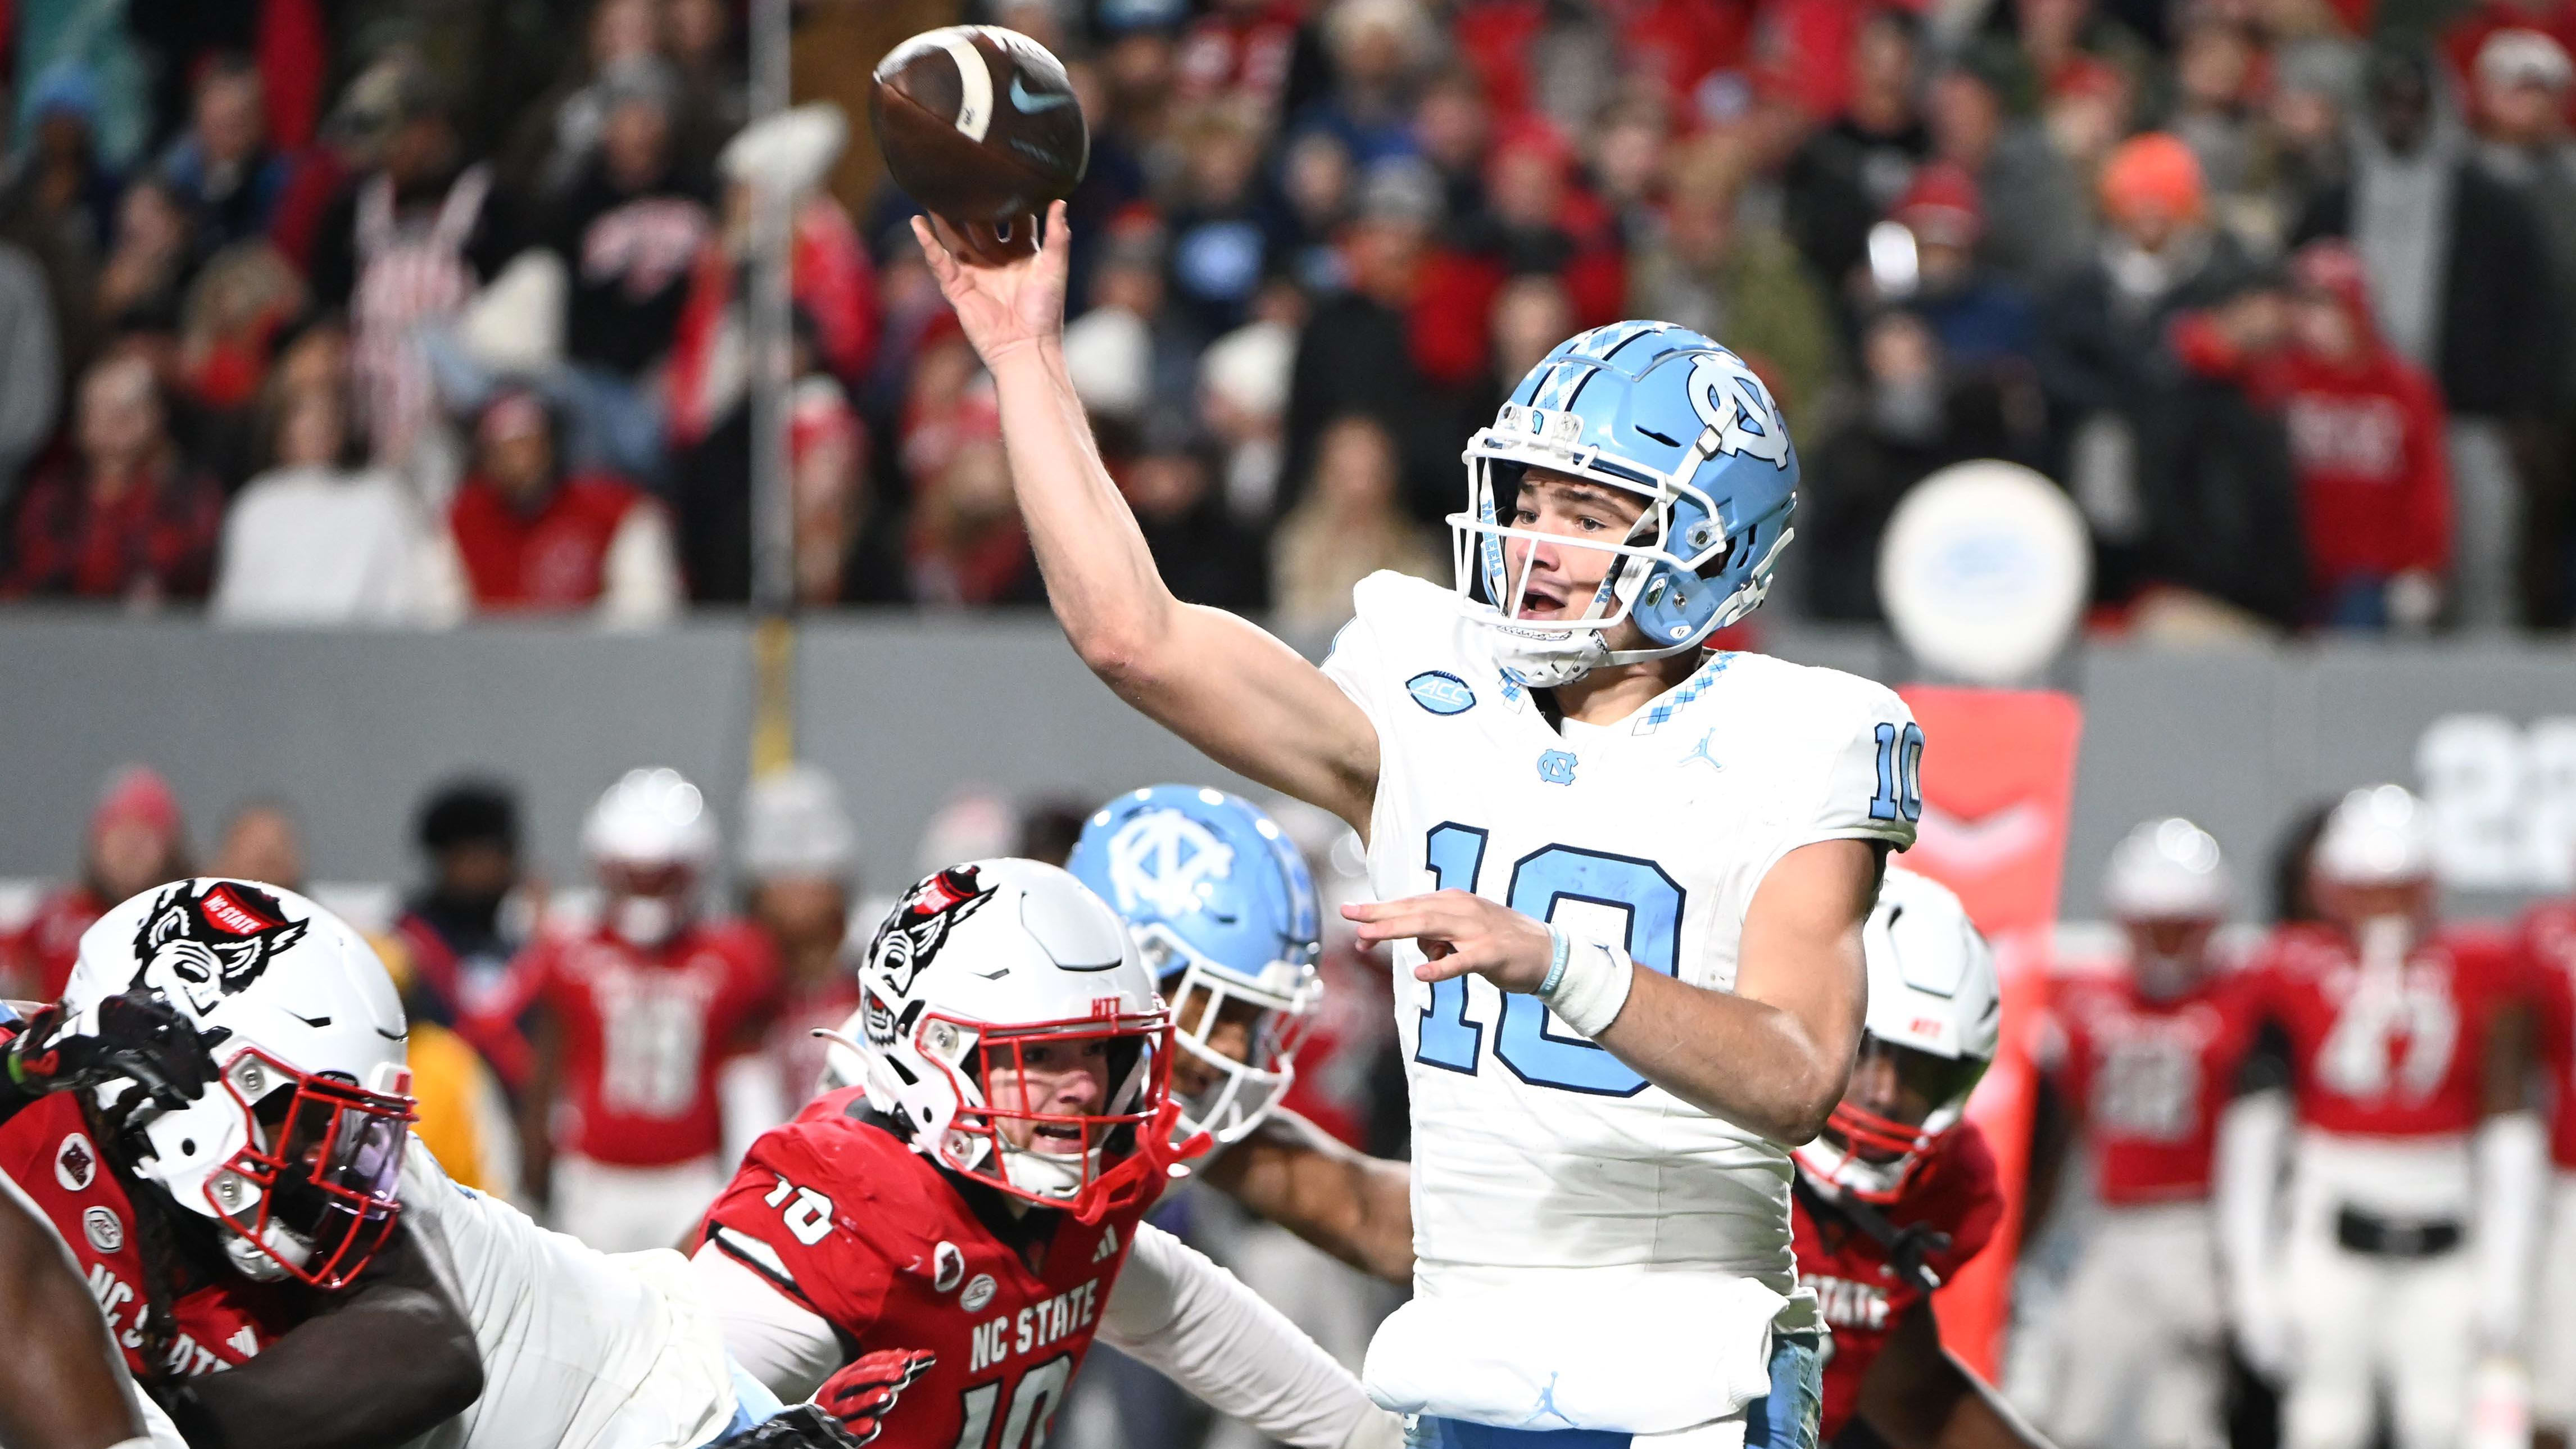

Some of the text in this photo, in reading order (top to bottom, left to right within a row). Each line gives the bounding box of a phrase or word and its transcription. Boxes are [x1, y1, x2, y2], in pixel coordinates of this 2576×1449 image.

[1414, 679, 1470, 703] ACC
[1869, 722, 1925, 822] 10
[198, 895, 261, 934] NC STATE
[1414, 821, 1686, 1098] 10
[763, 1172, 835, 1246] 10
[970, 1278, 1098, 1372] NC STATE
